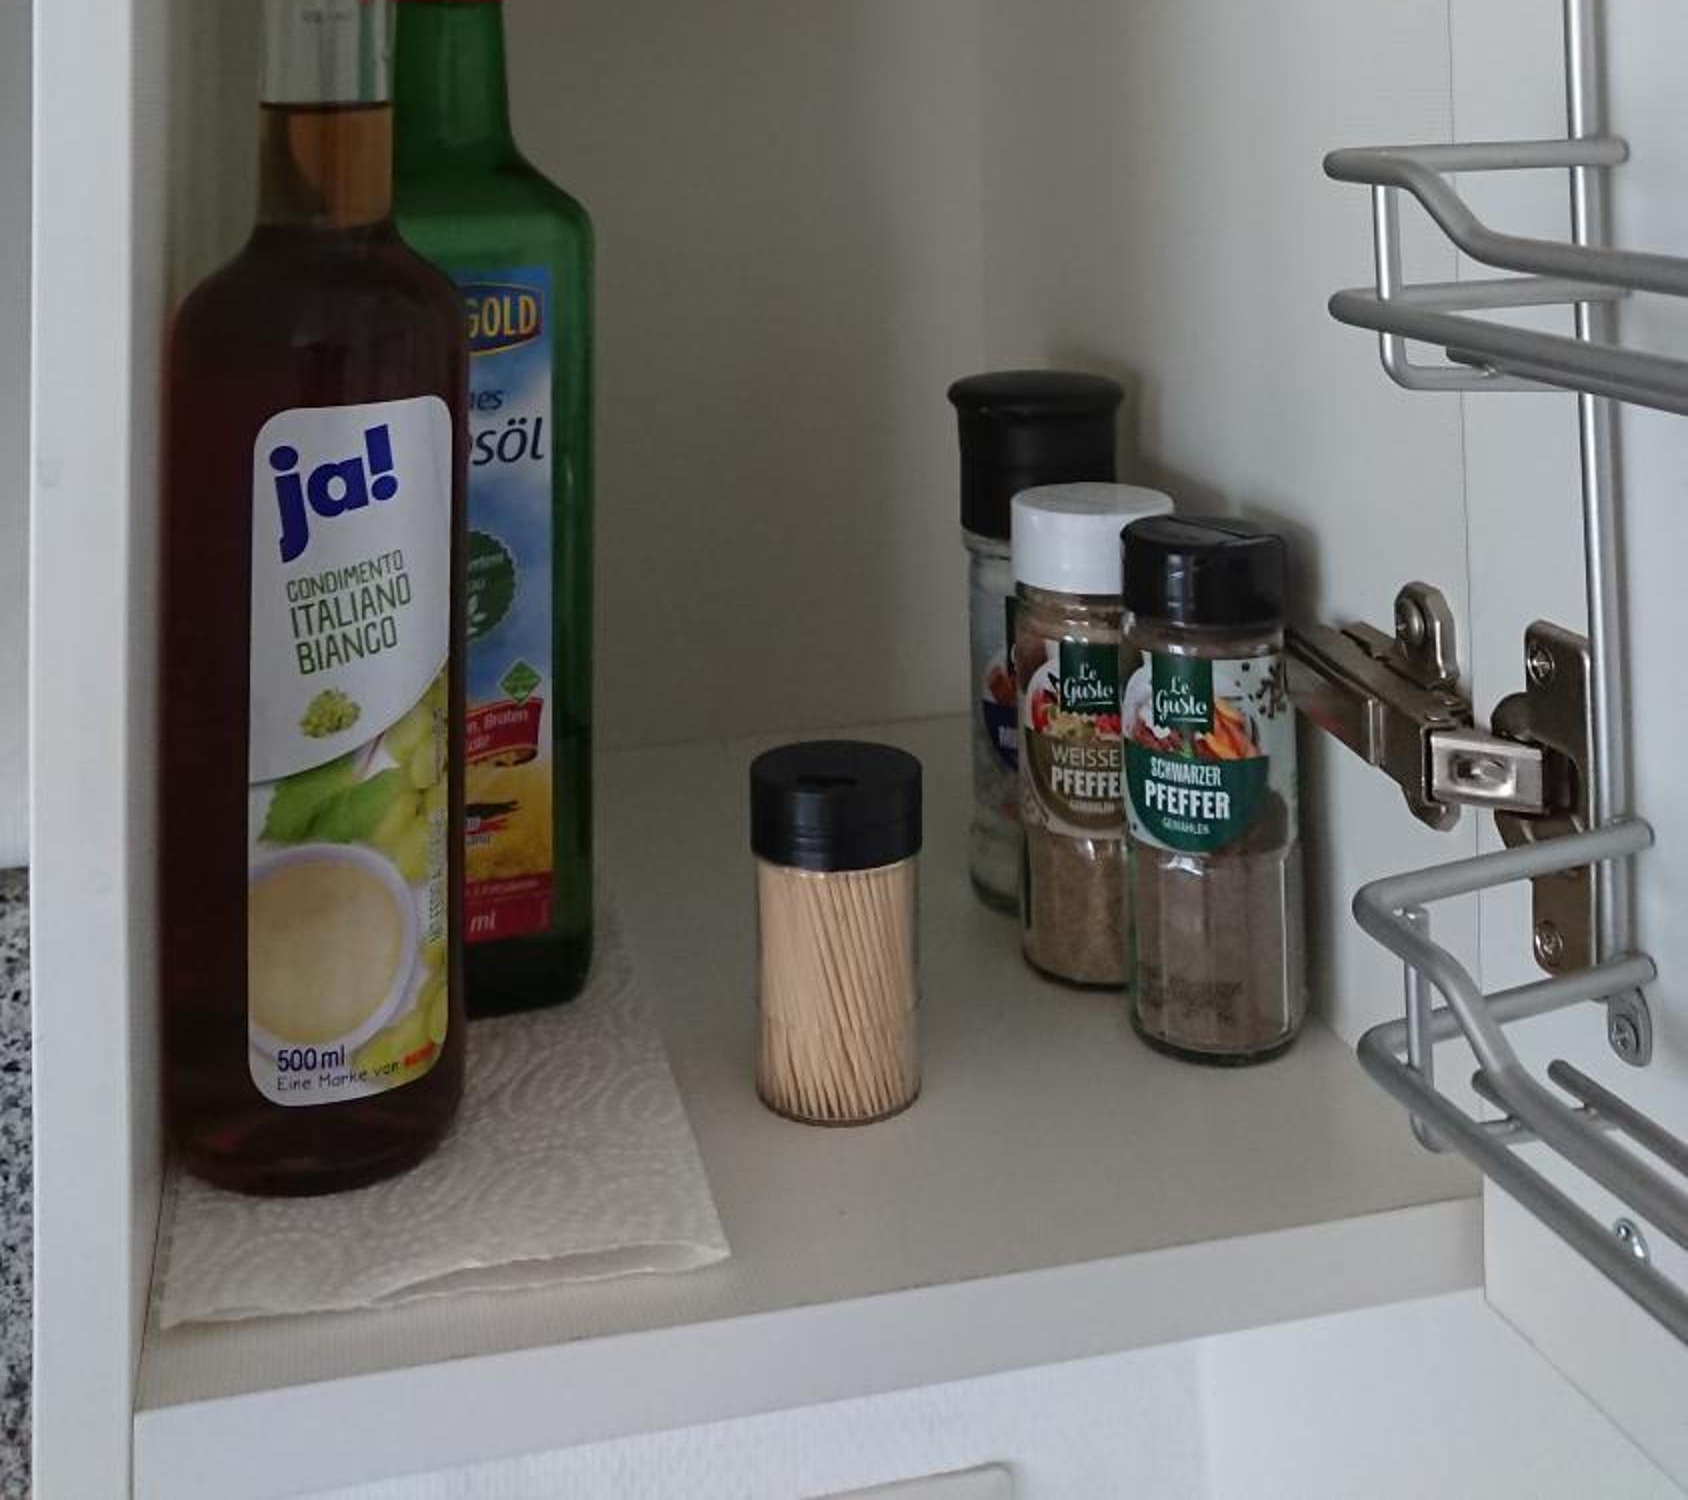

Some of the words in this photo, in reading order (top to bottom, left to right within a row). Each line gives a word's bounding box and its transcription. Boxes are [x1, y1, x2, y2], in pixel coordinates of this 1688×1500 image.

[468, 417, 545, 465] söl
[269, 424, 399, 562] ja!
[286, 549, 405, 602] CONDIMENTO
[290, 574, 411, 638] ITALIANO
[295, 616, 398, 675] BIANCO
[1079, 662, 1097, 680] Le
[1171, 676, 1189, 694] Le
[1063, 677, 1115, 707] Gusto
[1156, 689, 1208, 723] Gusto
[1051, 741, 1121, 767] WEISSE
[1051, 765, 1122, 799] PFEFFE
[1150, 756, 1222, 787] SCHWARZER
[1144, 779, 1232, 821] PFEFFER
[277, 1048, 317, 1072] 500
[321, 1044, 345, 1068] ml
[277, 1077, 312, 1091] Eine
[319, 1070, 368, 1089] Marke
